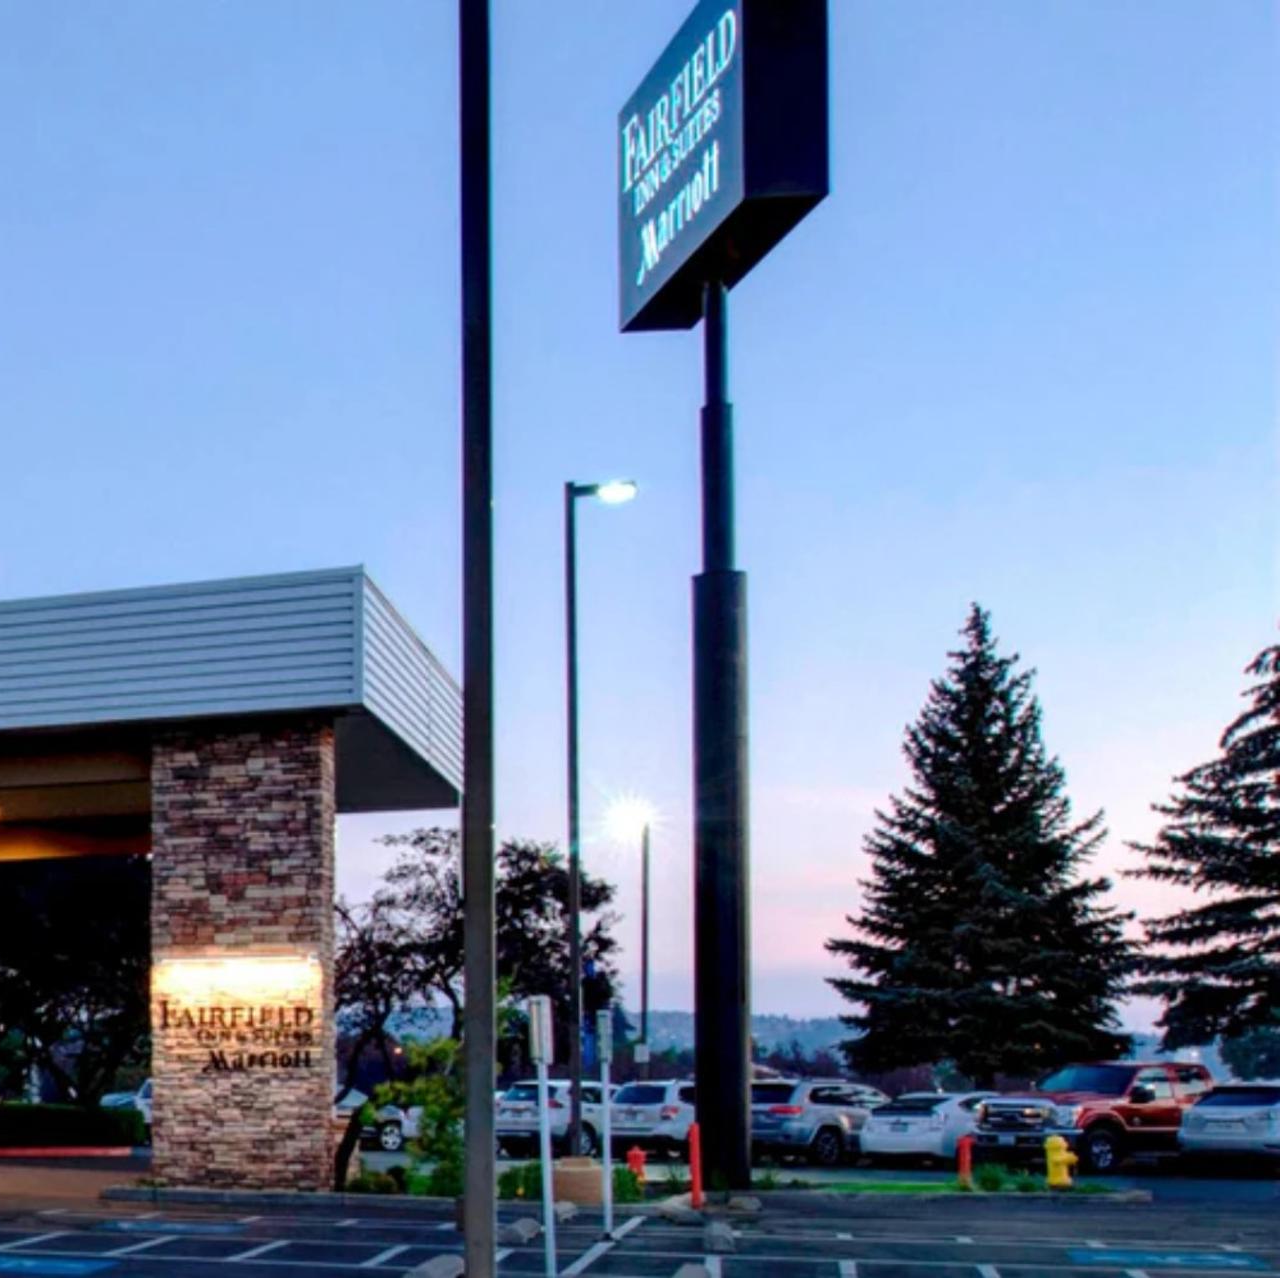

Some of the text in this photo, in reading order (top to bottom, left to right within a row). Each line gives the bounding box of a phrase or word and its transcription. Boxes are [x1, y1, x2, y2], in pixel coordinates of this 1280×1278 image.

[622, 9, 737, 192] FAIRFIELD
[636, 140, 720, 286] Marriott
[160, 1000, 314, 1029] FAIRFIELD
[202, 1050, 312, 1073] Marriott
